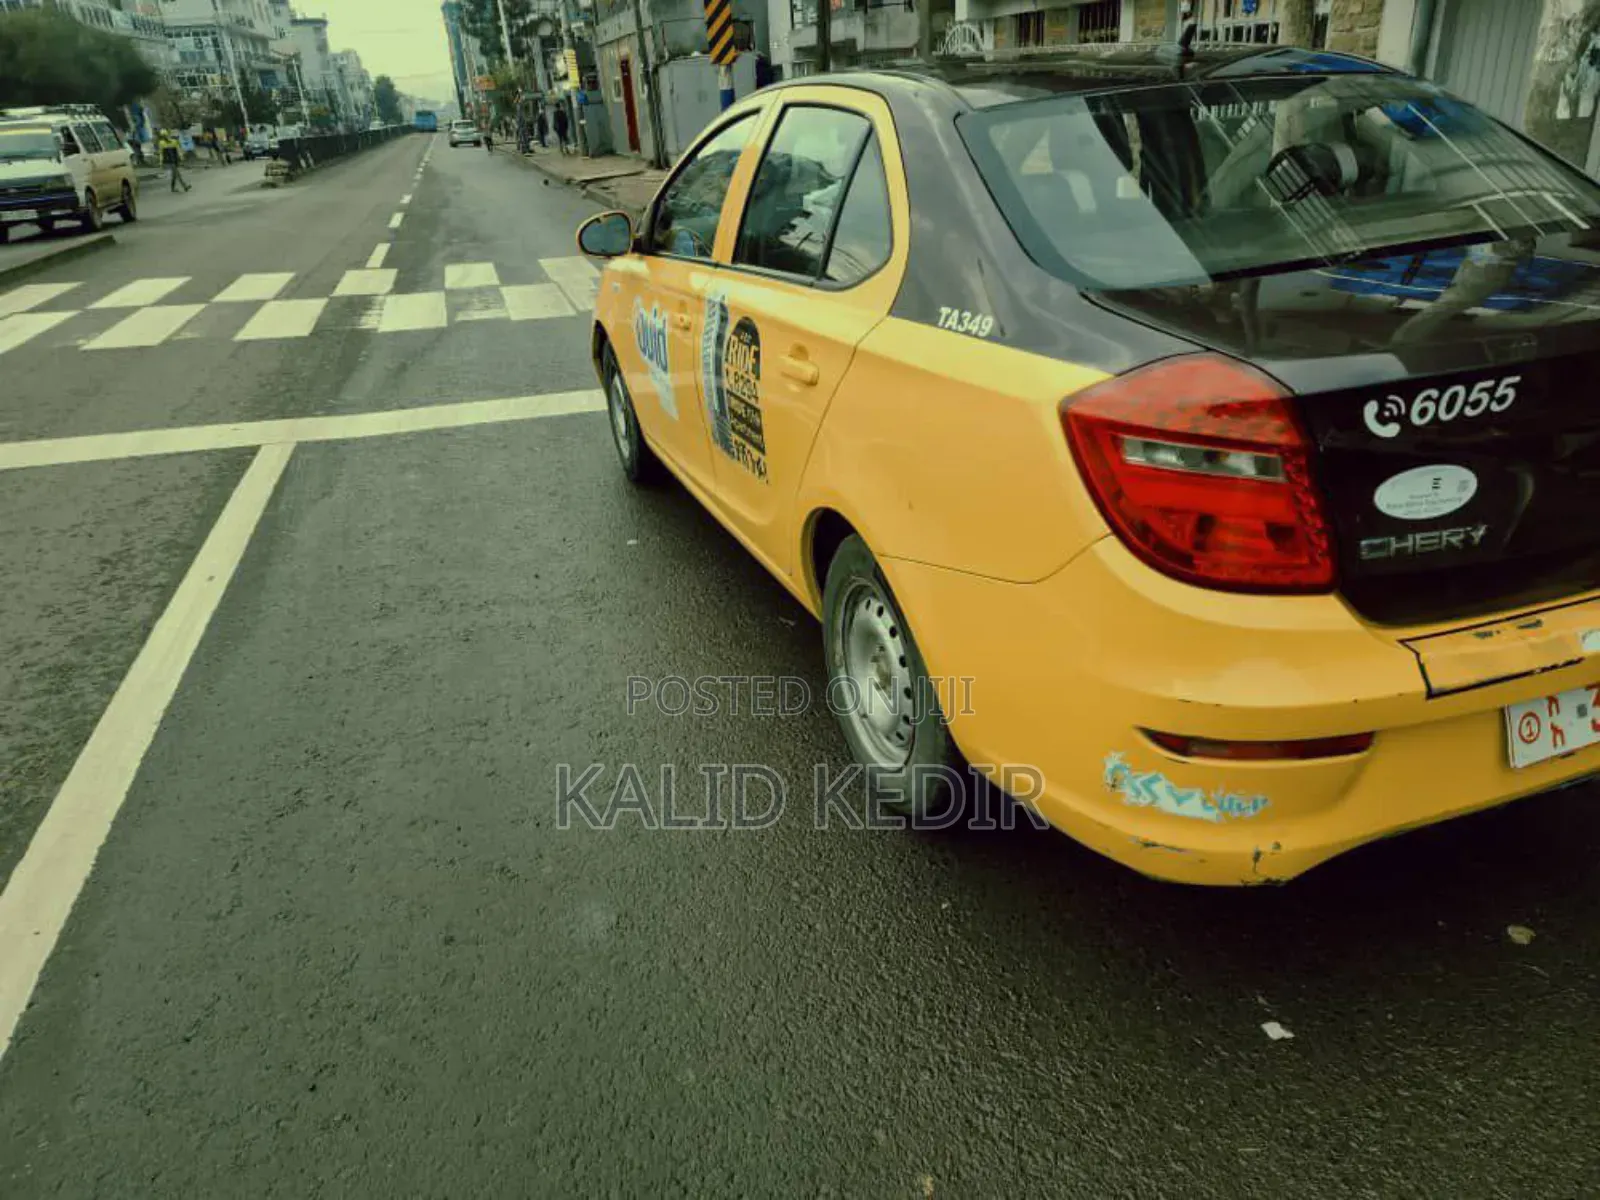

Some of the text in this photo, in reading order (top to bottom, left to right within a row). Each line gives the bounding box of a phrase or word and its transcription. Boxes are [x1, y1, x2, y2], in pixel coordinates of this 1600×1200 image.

[938, 306, 994, 337] TA349
[728, 334, 759, 373] RIDE
[1410, 375, 1522, 426] 6055
[1360, 524, 1488, 560] CHERY
